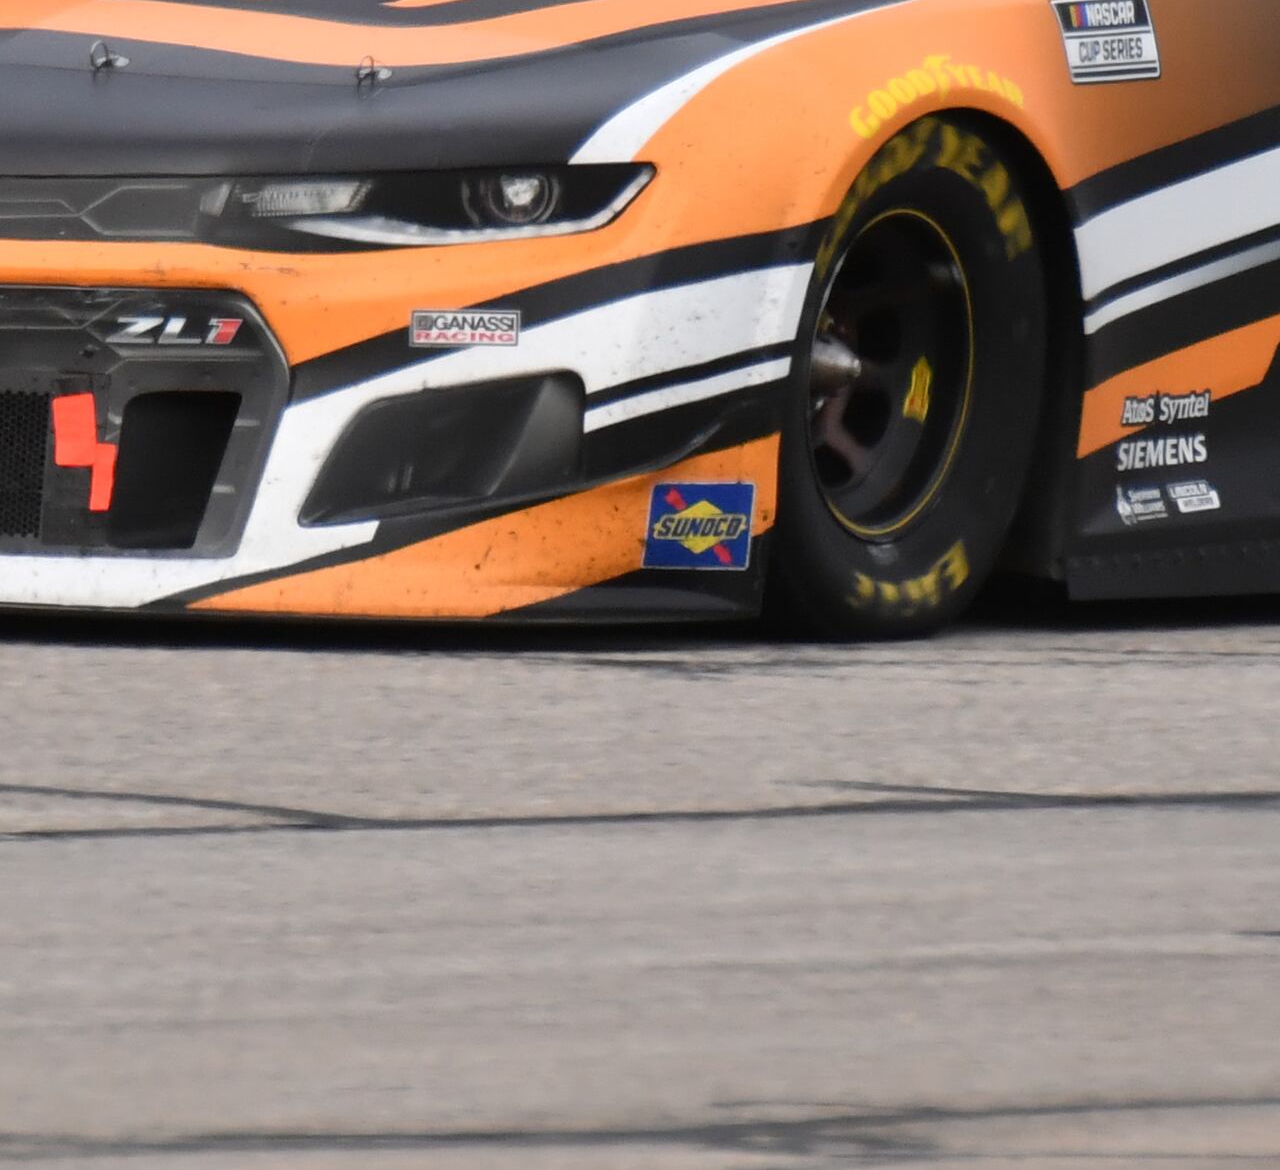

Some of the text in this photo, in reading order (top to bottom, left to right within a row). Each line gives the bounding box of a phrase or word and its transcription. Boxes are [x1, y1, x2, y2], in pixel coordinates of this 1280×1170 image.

[1086, 0, 1136, 28] NASCAR
[1078, 37, 1144, 63] CUP SERIES
[104, 316, 245, 345] ZL1
[433, 315, 515, 332] GANASSI
[415, 332, 514, 342] RACING
[1116, 434, 1208, 472] SIEMENS
[656, 516, 744, 537] SUNOCO
